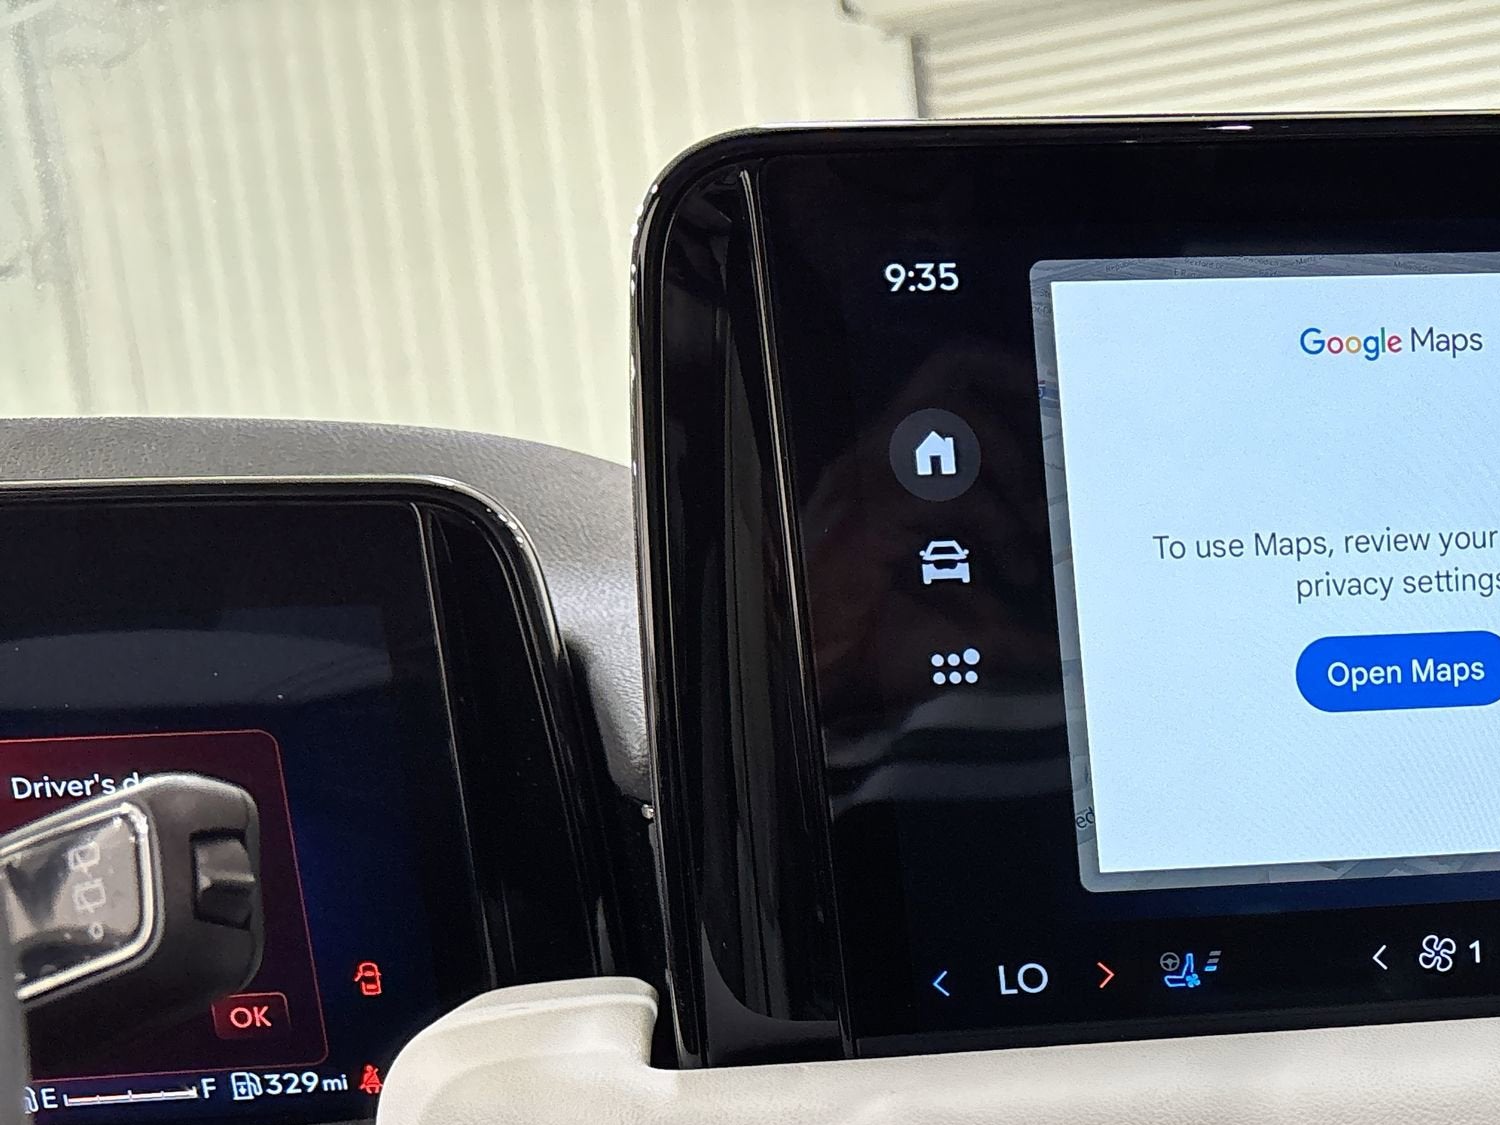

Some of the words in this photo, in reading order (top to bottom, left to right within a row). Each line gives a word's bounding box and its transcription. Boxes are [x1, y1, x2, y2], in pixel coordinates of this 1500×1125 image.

[884, 262, 959, 292] 9:35
[1299, 326, 1402, 362] Google
[1410, 326, 1483, 359] Maps
[1152, 535, 1186, 560] To
[1195, 538, 1244, 559] use
[1254, 532, 1334, 562] Maps,
[1344, 526, 1431, 554] review
[1438, 530, 1499, 557] your
[1297, 571, 1394, 605] privacy
[1327, 659, 1403, 692] Open
[1411, 658, 1486, 688] Maps
[11, 773, 117, 800] Driver's
[1468, 939, 1481, 964] 1
[998, 962, 1049, 995] LO
[229, 1005, 272, 1029] OK
[200, 1077, 217, 1099] F
[263, 1071, 319, 1095] 329
[323, 1073, 348, 1092] mi
[40, 1087, 59, 1109] E
